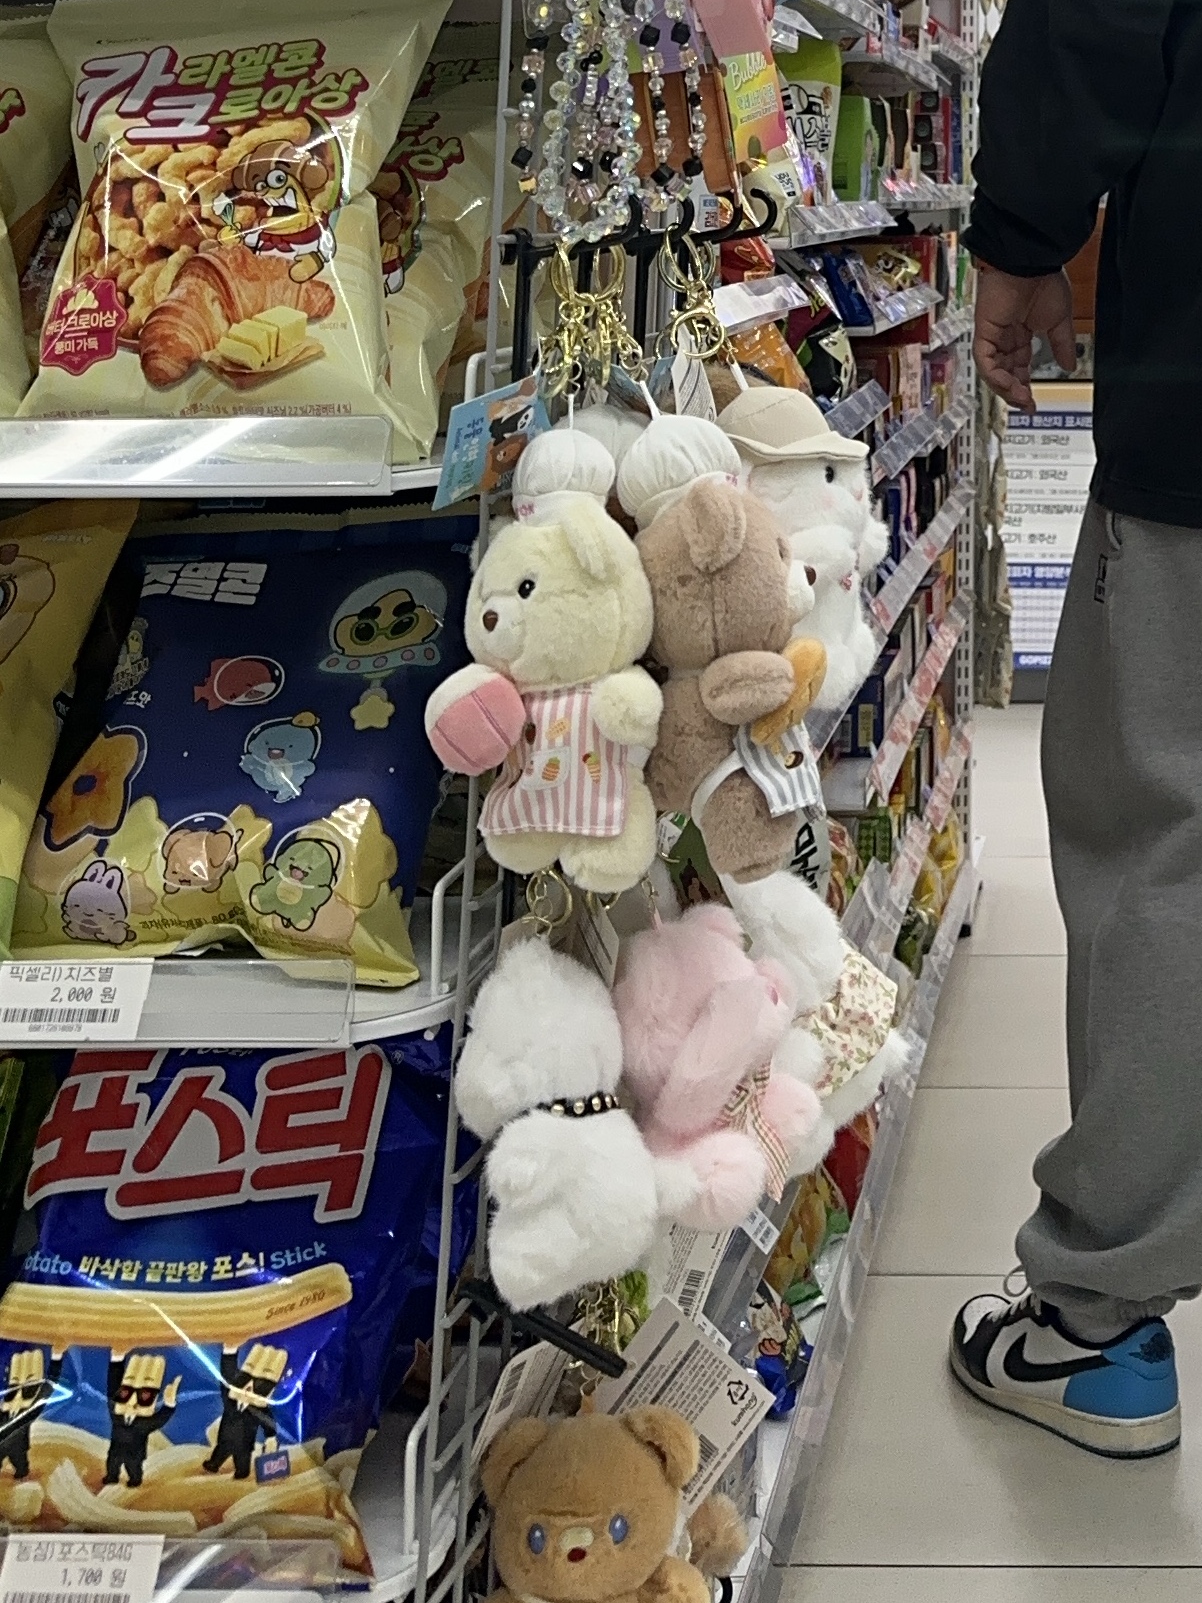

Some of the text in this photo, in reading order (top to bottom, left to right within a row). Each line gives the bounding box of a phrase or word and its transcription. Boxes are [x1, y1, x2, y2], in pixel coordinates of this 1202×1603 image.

[77, 38, 326, 141] 카라멜콘
[124, 68, 369, 143] 크로아상
[77, 338, 99, 352] 가득
[10, 966, 114, 983] 픽셀리)치즈별
[50, 986, 117, 1003] 2,000 원
[26, 1046, 387, 1221] 포스틱
[25, 1251, 72, 1274] otato
[211, 1251, 266, 1282] 포스!
[270, 1240, 327, 1270] Stick
[266, 1289, 326, 1320] Since 1980
[61, 1568, 127, 1589] 1,700 원
